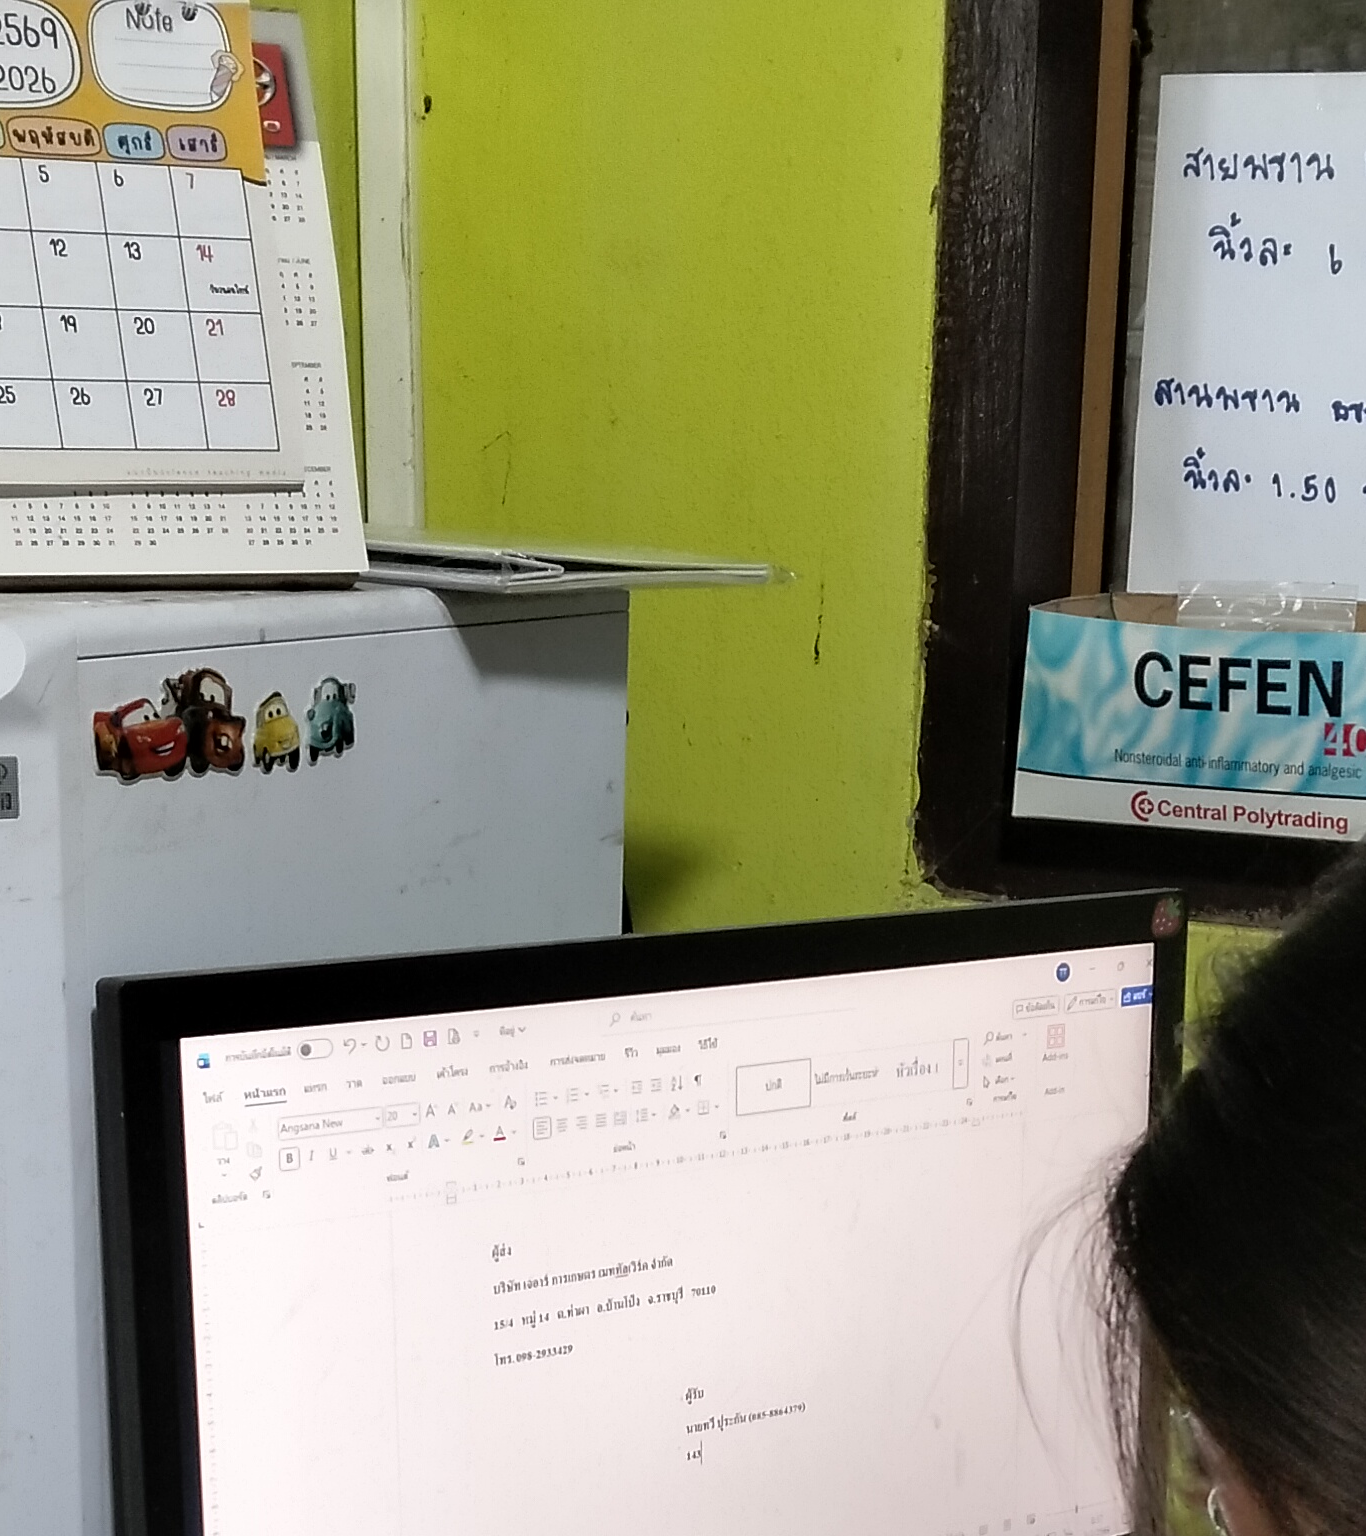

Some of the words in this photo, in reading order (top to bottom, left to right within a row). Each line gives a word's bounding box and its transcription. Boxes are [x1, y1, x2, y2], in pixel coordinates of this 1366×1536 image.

[125, 7, 173, 32] Note
[12, 124, 96, 150] พฤหัสบดี
[117, 131, 152, 153] ศุกร์
[179, 132, 218, 153] เสาร์
[39, 165, 49, 183] 5
[114, 170, 124, 187] 6
[185, 173, 194, 189] 7
[49, 238, 68, 257] 12
[123, 241, 142, 260] 13
[196, 245, 213, 263] 14
[60, 315, 77, 333] 19
[134, 317, 155, 335] 20
[206, 318, 224, 336] 21
[69, 387, 91, 406] 26
[143, 388, 163, 406] 27
[215, 389, 235, 407] 28
[1272, 472, 1337, 503] 1.50
[1134, 650, 1344, 718] CEFEN
[1115, 748, 1182, 767] Nonsteroidal
[1185, 755, 1279, 776] anti-inflammatory
[1284, 761, 1304, 776] and
[1308, 762, 1362, 781] analgesic
[1157, 799, 1227, 822] Central
[1233, 805, 1348, 835] Polytrading
[244, 1087, 287, 1100] หน้าแรก
[280, 1122, 320, 1136] Angsana
[322, 1119, 343, 1130] New
[491, 1243, 512, 1263] ผู้ส่ง
[685, 1387, 704, 1405] ผู้รับ
